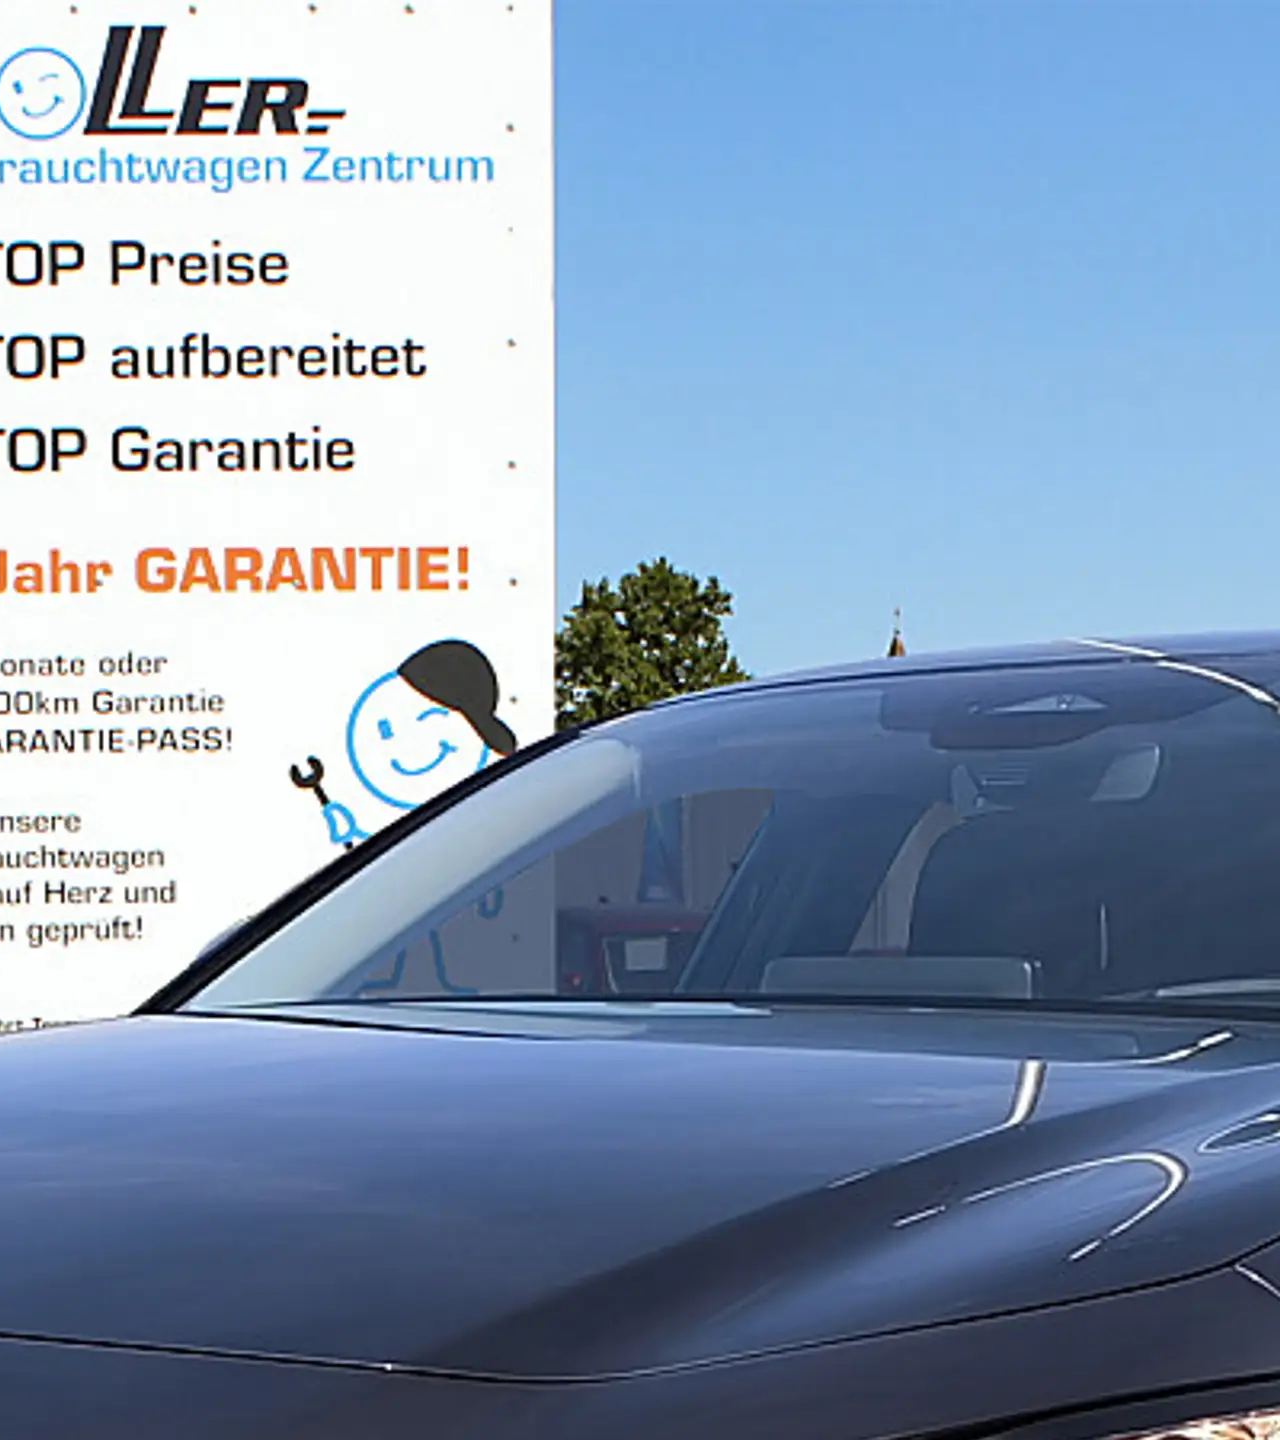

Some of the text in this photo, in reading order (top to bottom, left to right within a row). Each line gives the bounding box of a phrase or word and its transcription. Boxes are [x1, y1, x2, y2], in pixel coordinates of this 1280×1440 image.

[302, 147, 494, 181] Zentrum
[111, 239, 289, 286] Preise
[112, 332, 426, 379] aufbereitet
[112, 425, 354, 472] Garantie
[136, 547, 469, 593] GARANTIE!
[99, 652, 167, 676] oder
[93, 689, 224, 715] Garantie
[45, 881, 112, 904] Herz
[125, 881, 175, 903] und
[27, 916, 142, 948] geprüft!
